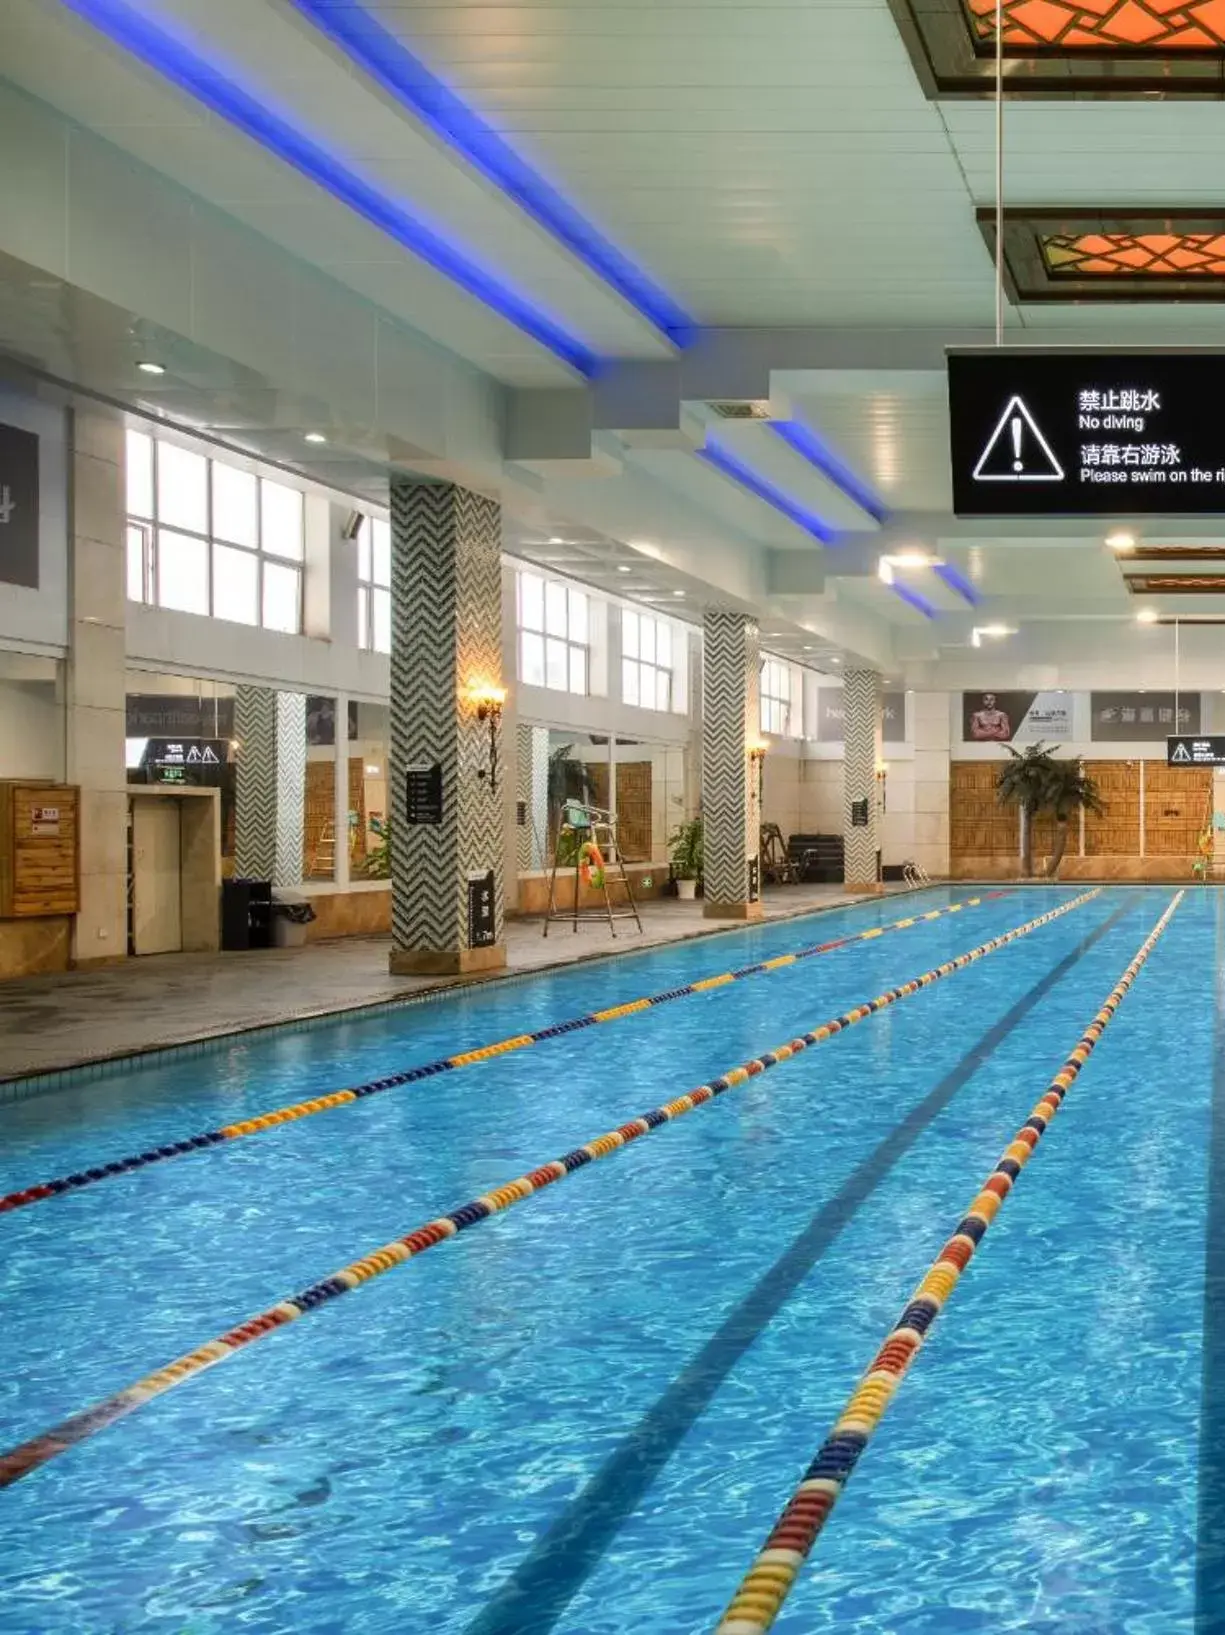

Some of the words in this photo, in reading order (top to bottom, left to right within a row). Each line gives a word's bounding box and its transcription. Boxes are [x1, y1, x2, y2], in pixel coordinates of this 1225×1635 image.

[1080, 389, 1160, 411] 禁止跳水
[1079, 414, 1100, 429] No
[1103, 414, 1144, 432] diving
[1081, 444, 1181, 465] 请靠右游泳
[1080, 468, 1128, 483] Please
[1131, 469, 1166, 482] swim
[1169, 471, 1187, 482] on
[1190, 468, 1213, 482] the
